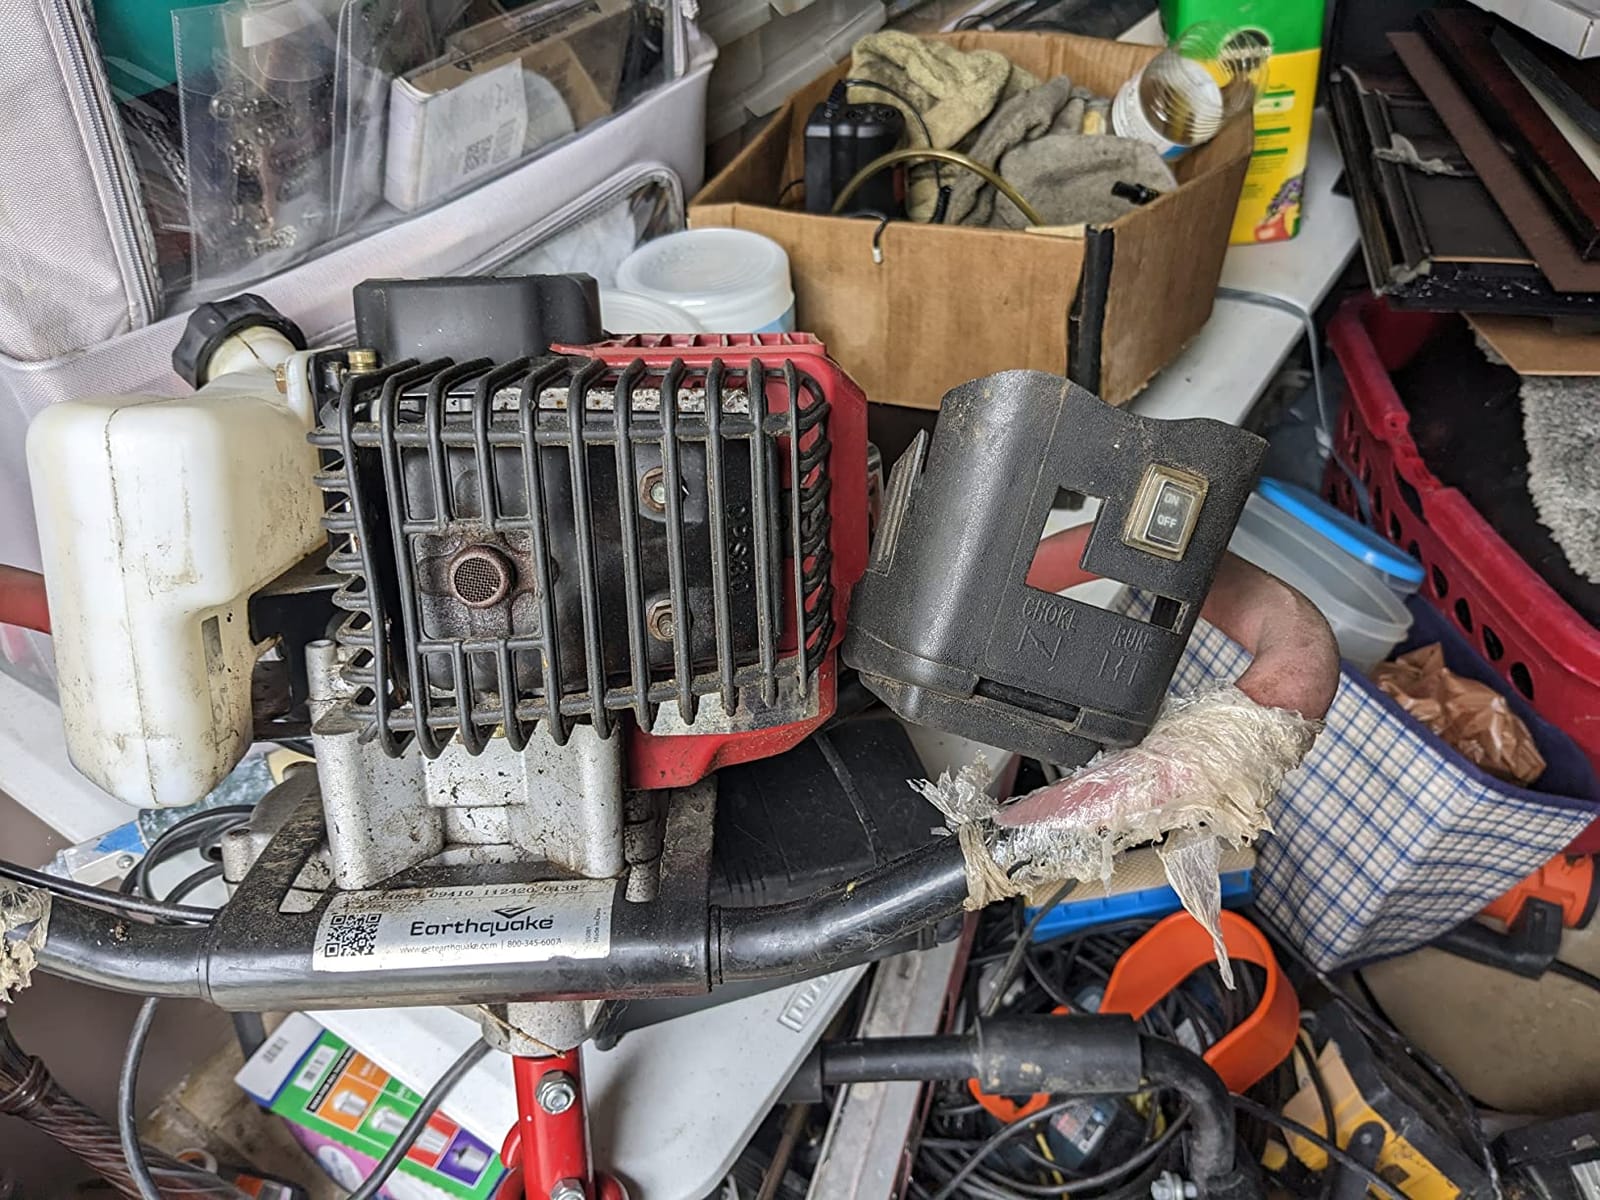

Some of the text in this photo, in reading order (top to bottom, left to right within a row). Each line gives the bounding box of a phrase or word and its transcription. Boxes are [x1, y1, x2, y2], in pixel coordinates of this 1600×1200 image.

[1164, 492, 1180, 506] ON
[1157, 514, 1178, 528] OFF
[1023, 597, 1077, 632] CHOKE
[1112, 623, 1150, 655] RUN
[429, 889, 474, 898] 09410
[410, 915, 553, 937] Earthquake
[400, 941, 498, 954] www.getearthquake.com
